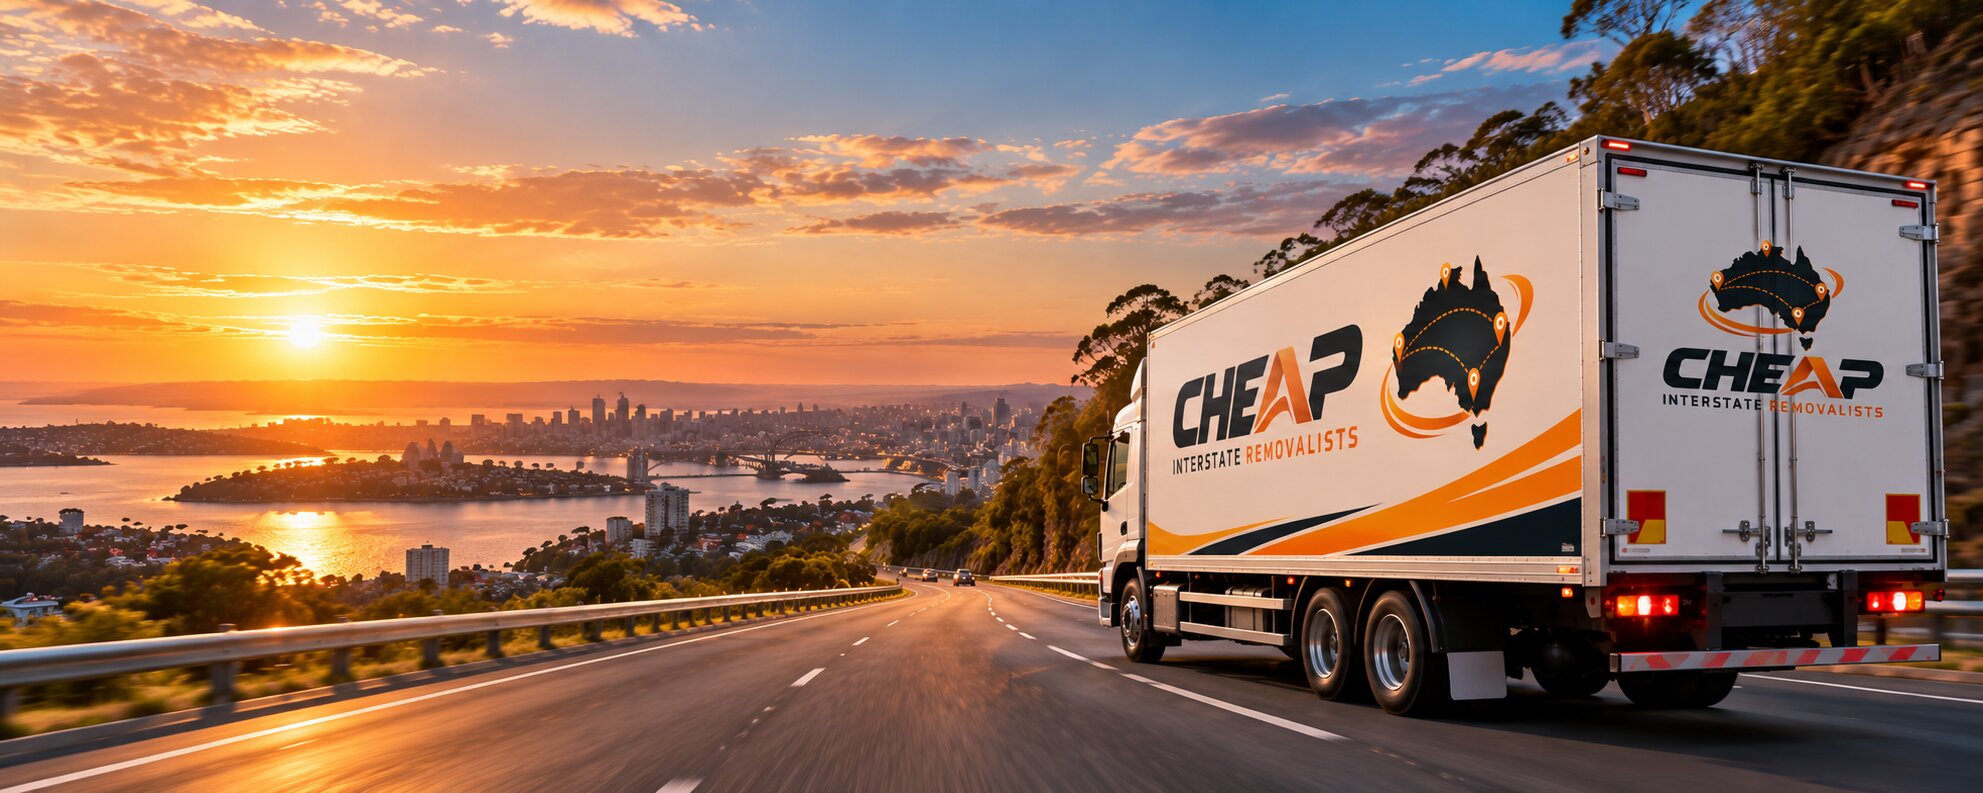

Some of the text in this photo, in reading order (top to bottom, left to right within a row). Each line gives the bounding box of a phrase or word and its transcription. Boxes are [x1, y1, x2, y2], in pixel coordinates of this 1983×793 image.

[1173, 324, 1362, 448] CHEAP
[1662, 347, 1884, 399] CHEAP
[1662, 393, 1883, 418] INTERSTATE REMOVALISTS
[1173, 426, 1358, 475] INTERSTATE REMOVALISTS
